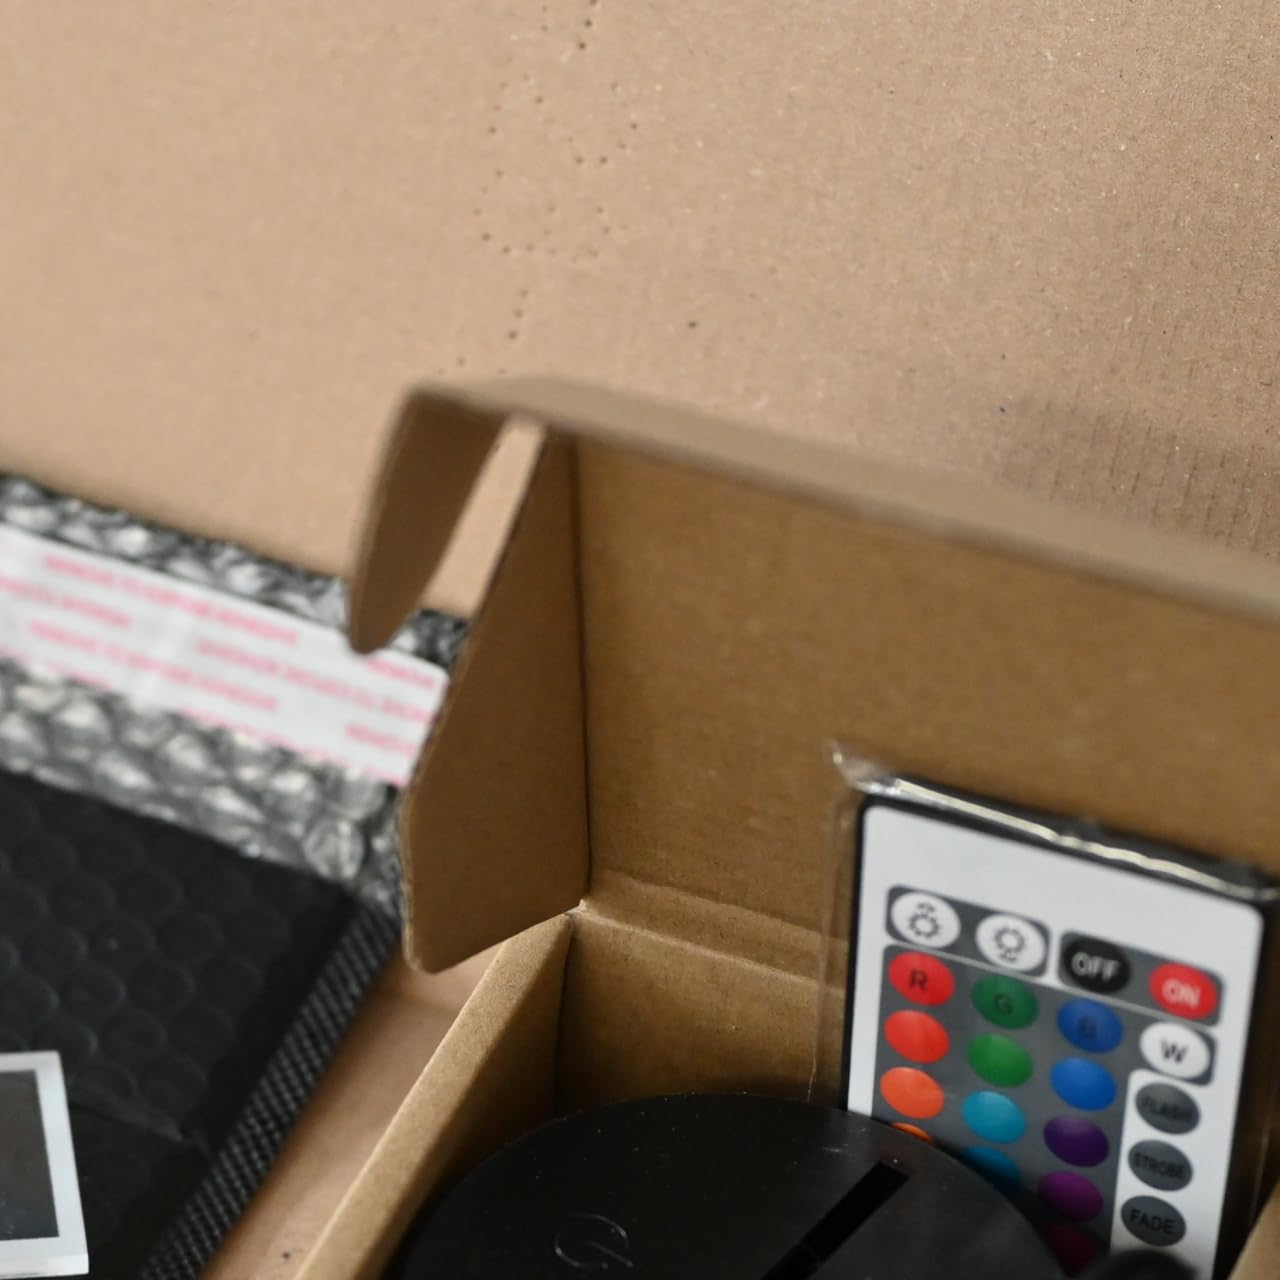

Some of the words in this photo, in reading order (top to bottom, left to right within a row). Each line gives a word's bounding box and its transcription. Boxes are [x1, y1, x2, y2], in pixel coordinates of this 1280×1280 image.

[1072, 953, 1119, 981] OFF
[909, 970, 927, 991] R
[994, 994, 1012, 1016] G
[1162, 981, 1200, 1009] ON
[1160, 1041, 1186, 1064] W
[1130, 1208, 1174, 1234] FADE
